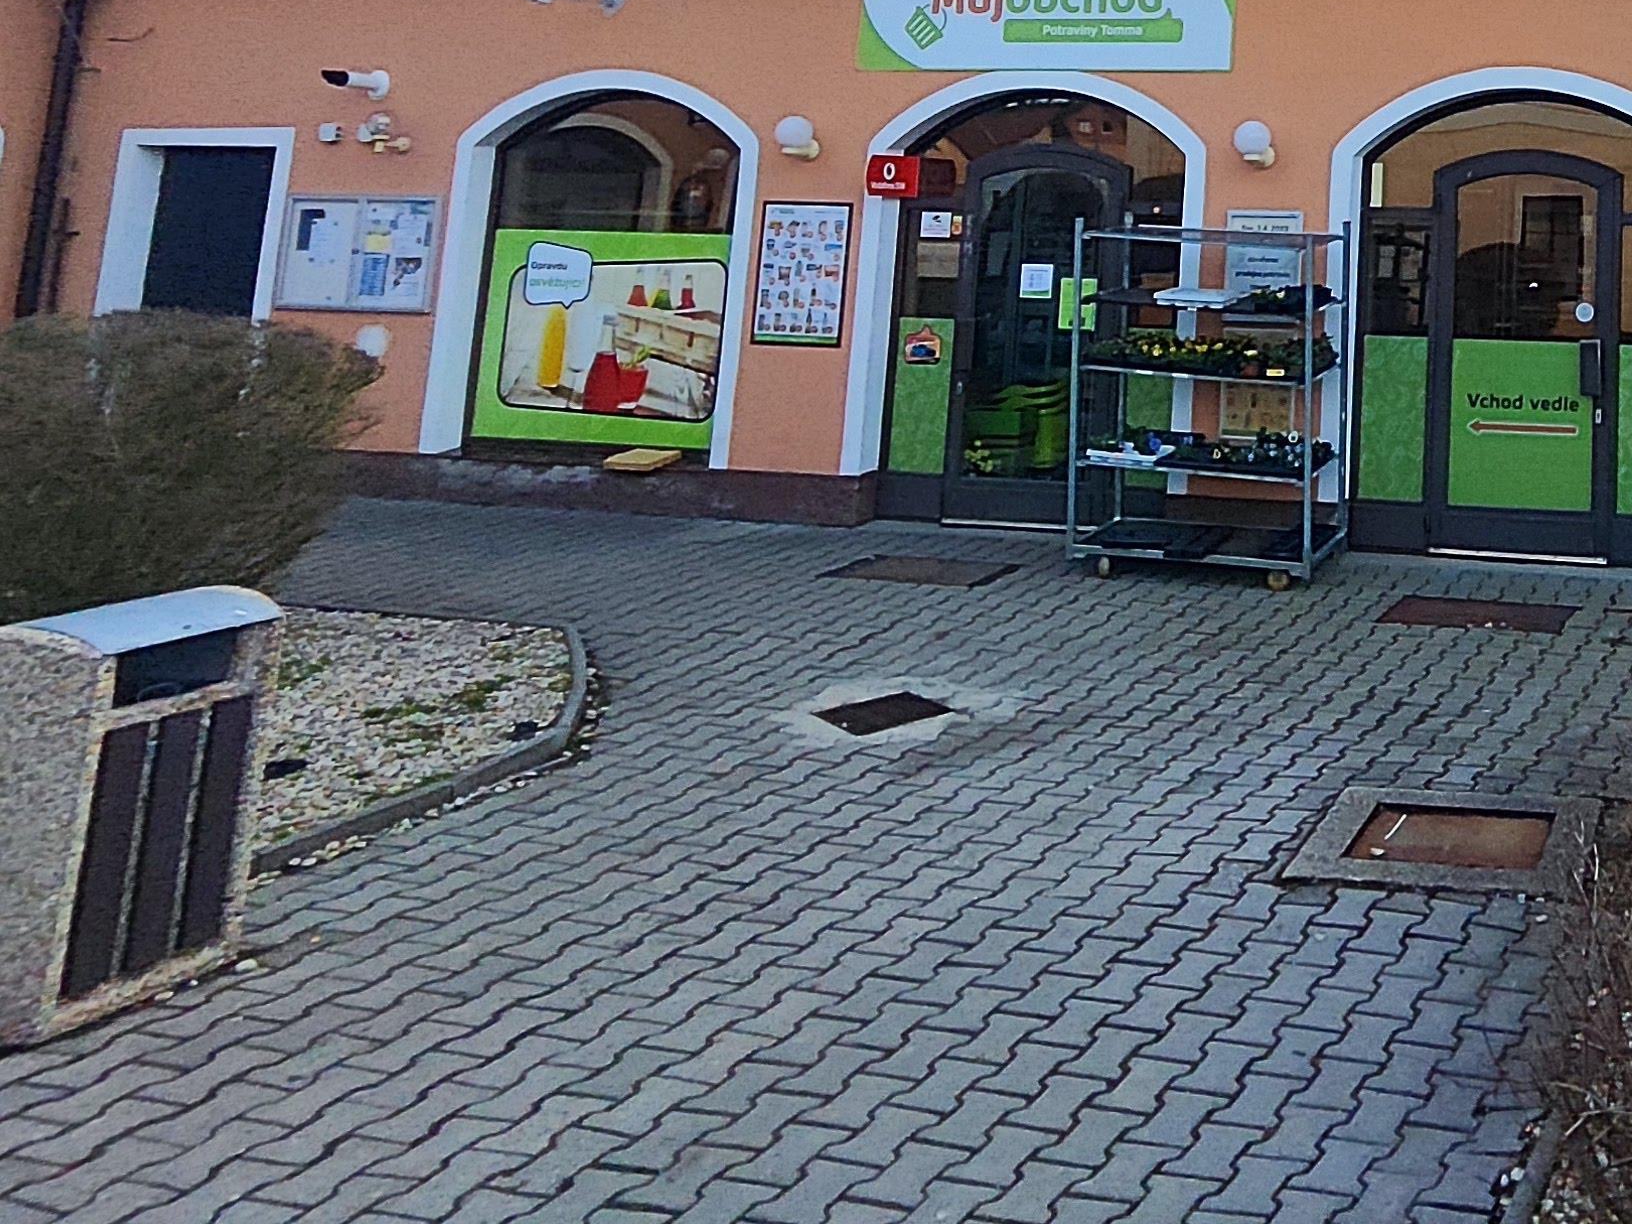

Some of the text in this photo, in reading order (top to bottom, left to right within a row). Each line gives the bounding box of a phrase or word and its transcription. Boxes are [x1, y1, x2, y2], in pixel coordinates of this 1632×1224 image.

[1042, 24, 1098, 38] Potraviny
[1466, 393, 1580, 412] Vchod vedle
